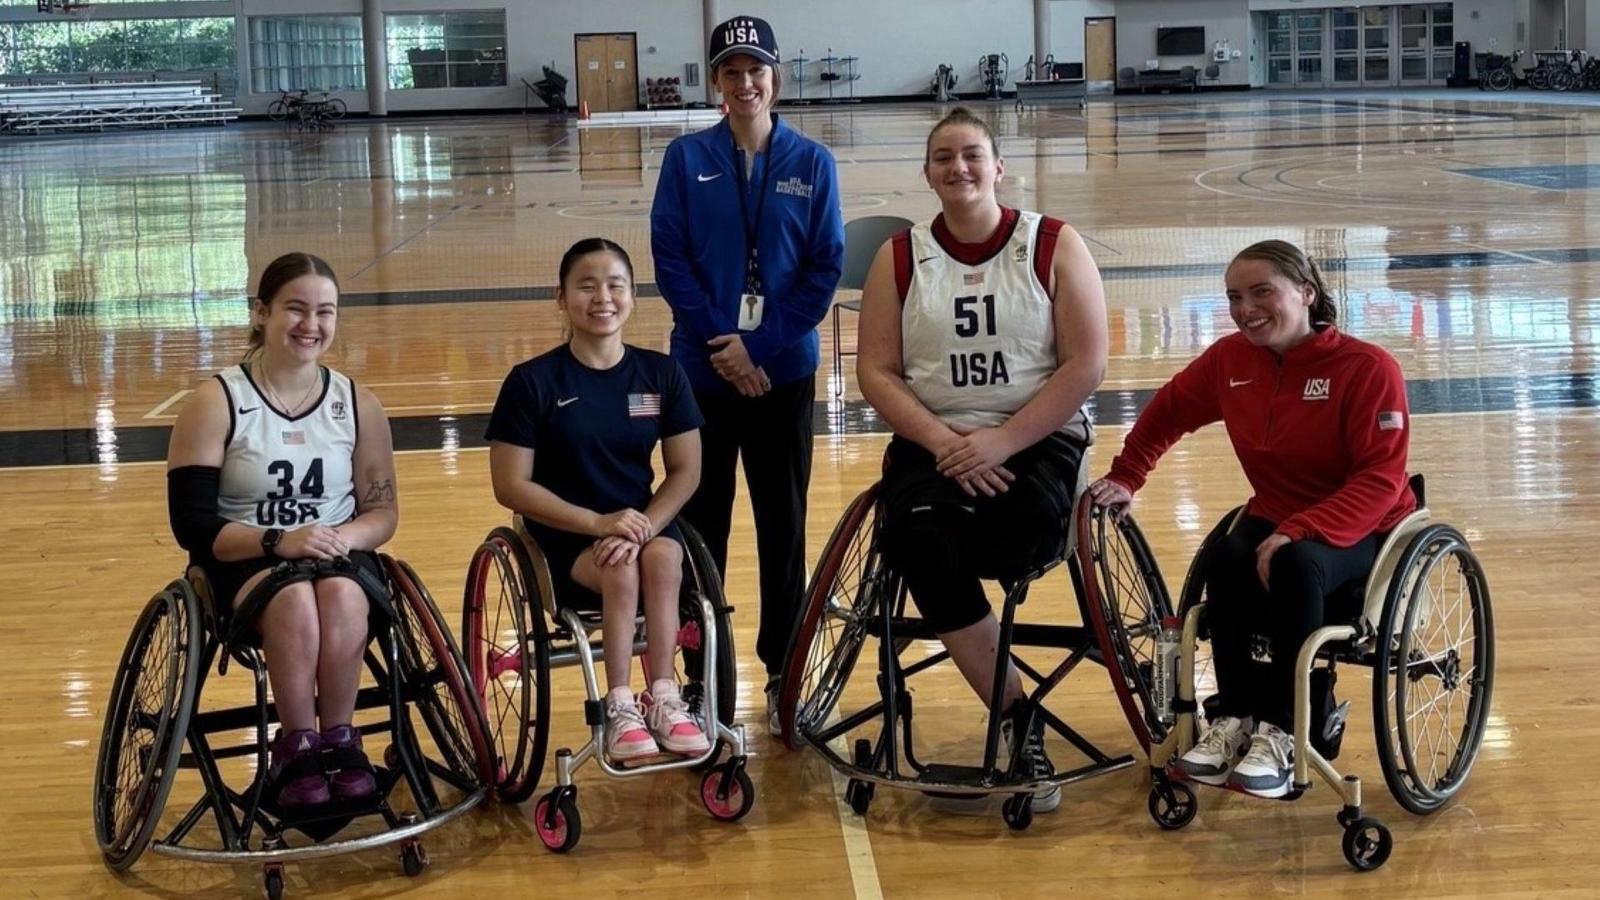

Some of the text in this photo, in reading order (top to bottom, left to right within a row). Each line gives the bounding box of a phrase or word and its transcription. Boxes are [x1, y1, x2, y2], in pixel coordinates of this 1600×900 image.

[725, 28, 759, 45] USA
[728, 20, 753, 28] TEAM
[955, 294, 997, 338] 51
[950, 351, 1009, 387] USA
[1304, 378, 1331, 396] USA
[267, 457, 324, 500] 34
[256, 499, 320, 526] USA
